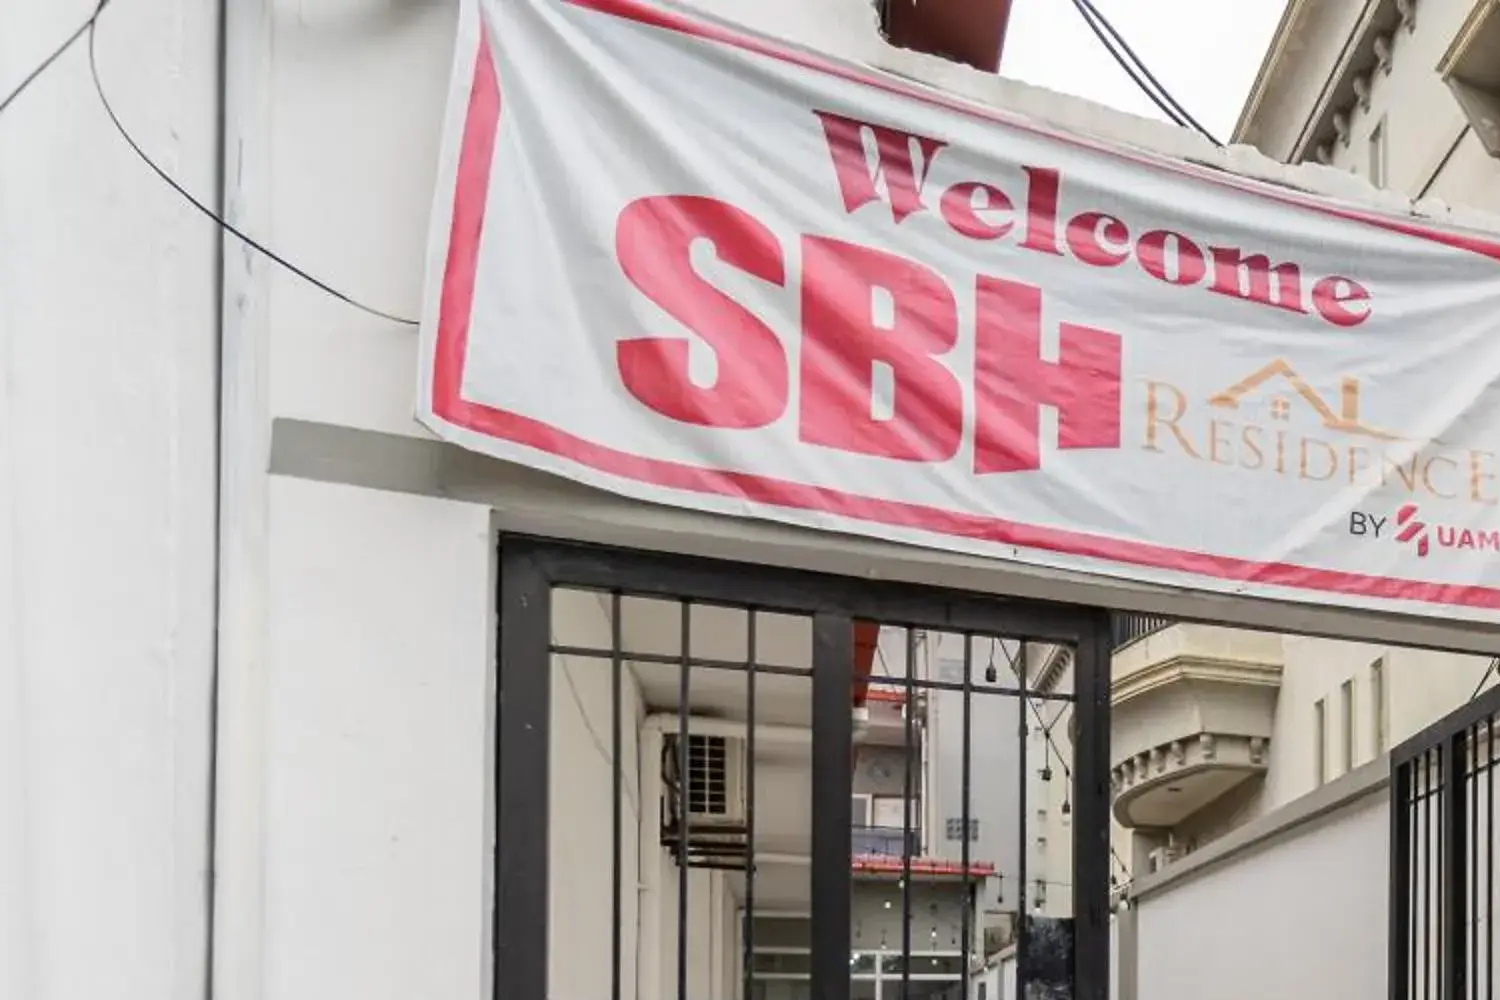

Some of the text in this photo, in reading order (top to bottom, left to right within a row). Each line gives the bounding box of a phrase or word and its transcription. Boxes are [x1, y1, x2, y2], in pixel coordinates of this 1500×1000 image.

[812, 109, 1374, 327] Welcome
[615, 194, 1122, 476] SBH
[1139, 377, 1498, 506] RESIDENCE
[1349, 511, 1387, 538] BY
